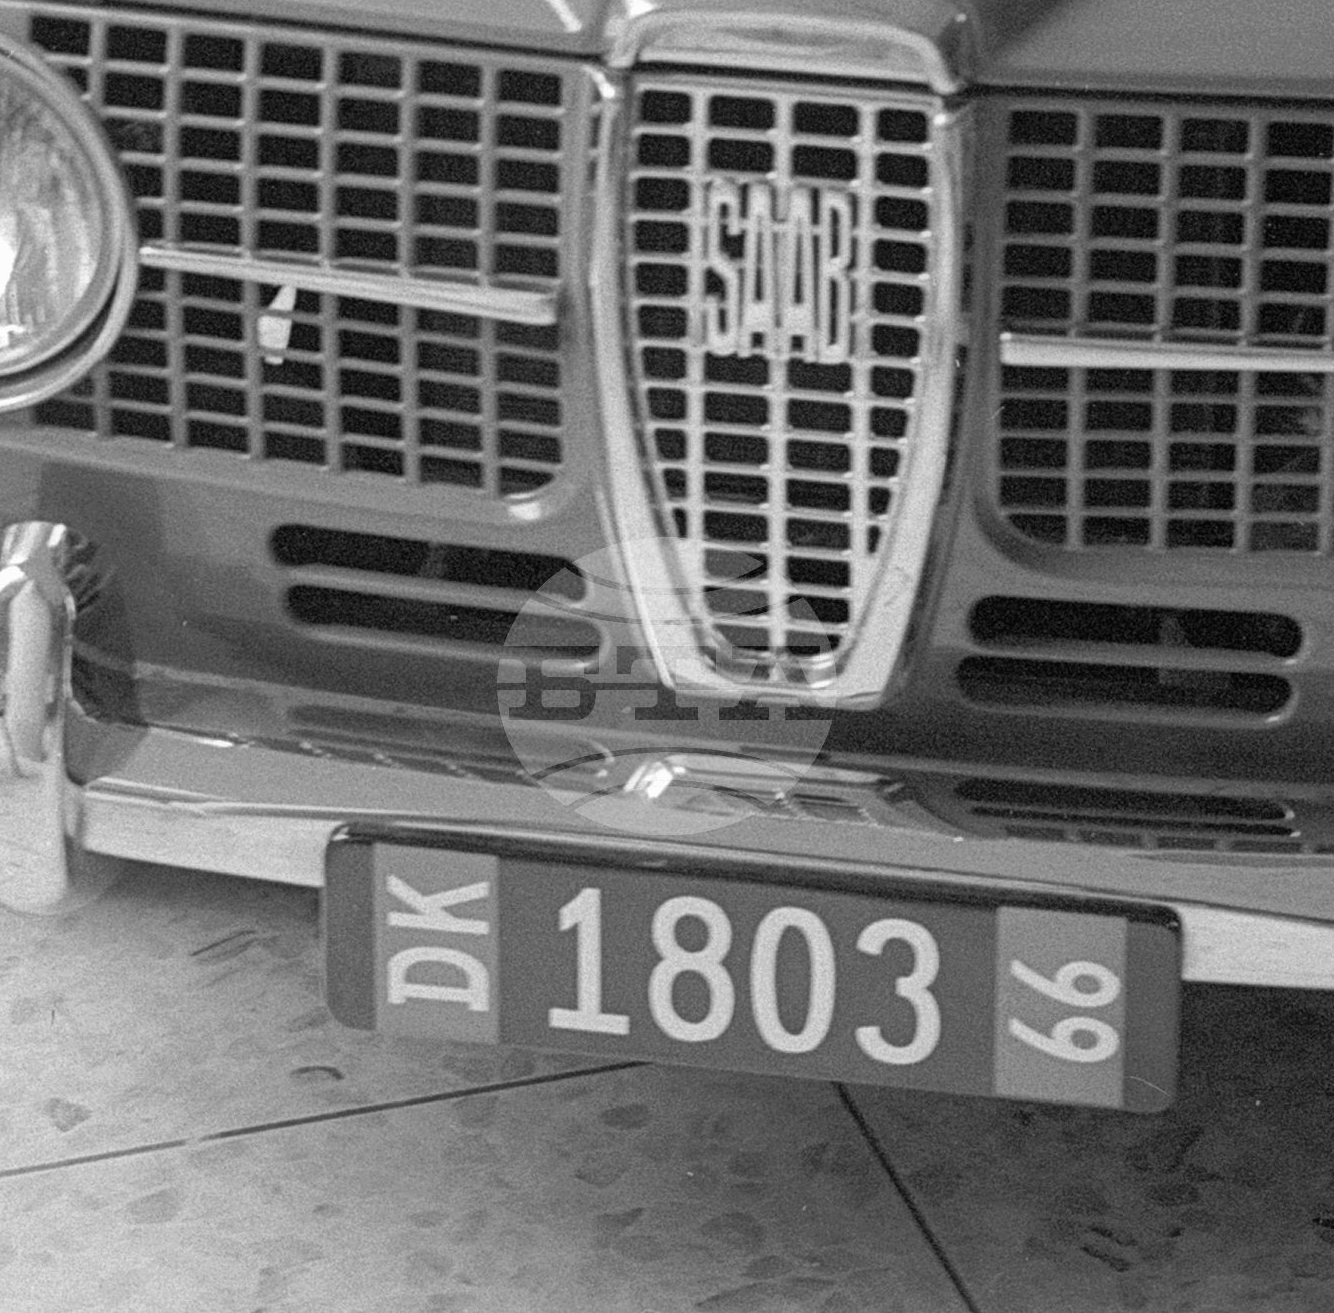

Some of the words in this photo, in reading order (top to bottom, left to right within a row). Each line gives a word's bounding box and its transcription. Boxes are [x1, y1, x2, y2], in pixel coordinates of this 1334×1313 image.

[706, 179, 852, 365] SAAB
[386, 875, 491, 1013] DK
[548, 887, 942, 1065] 1803
[1009, 960, 1122, 1065] 66
